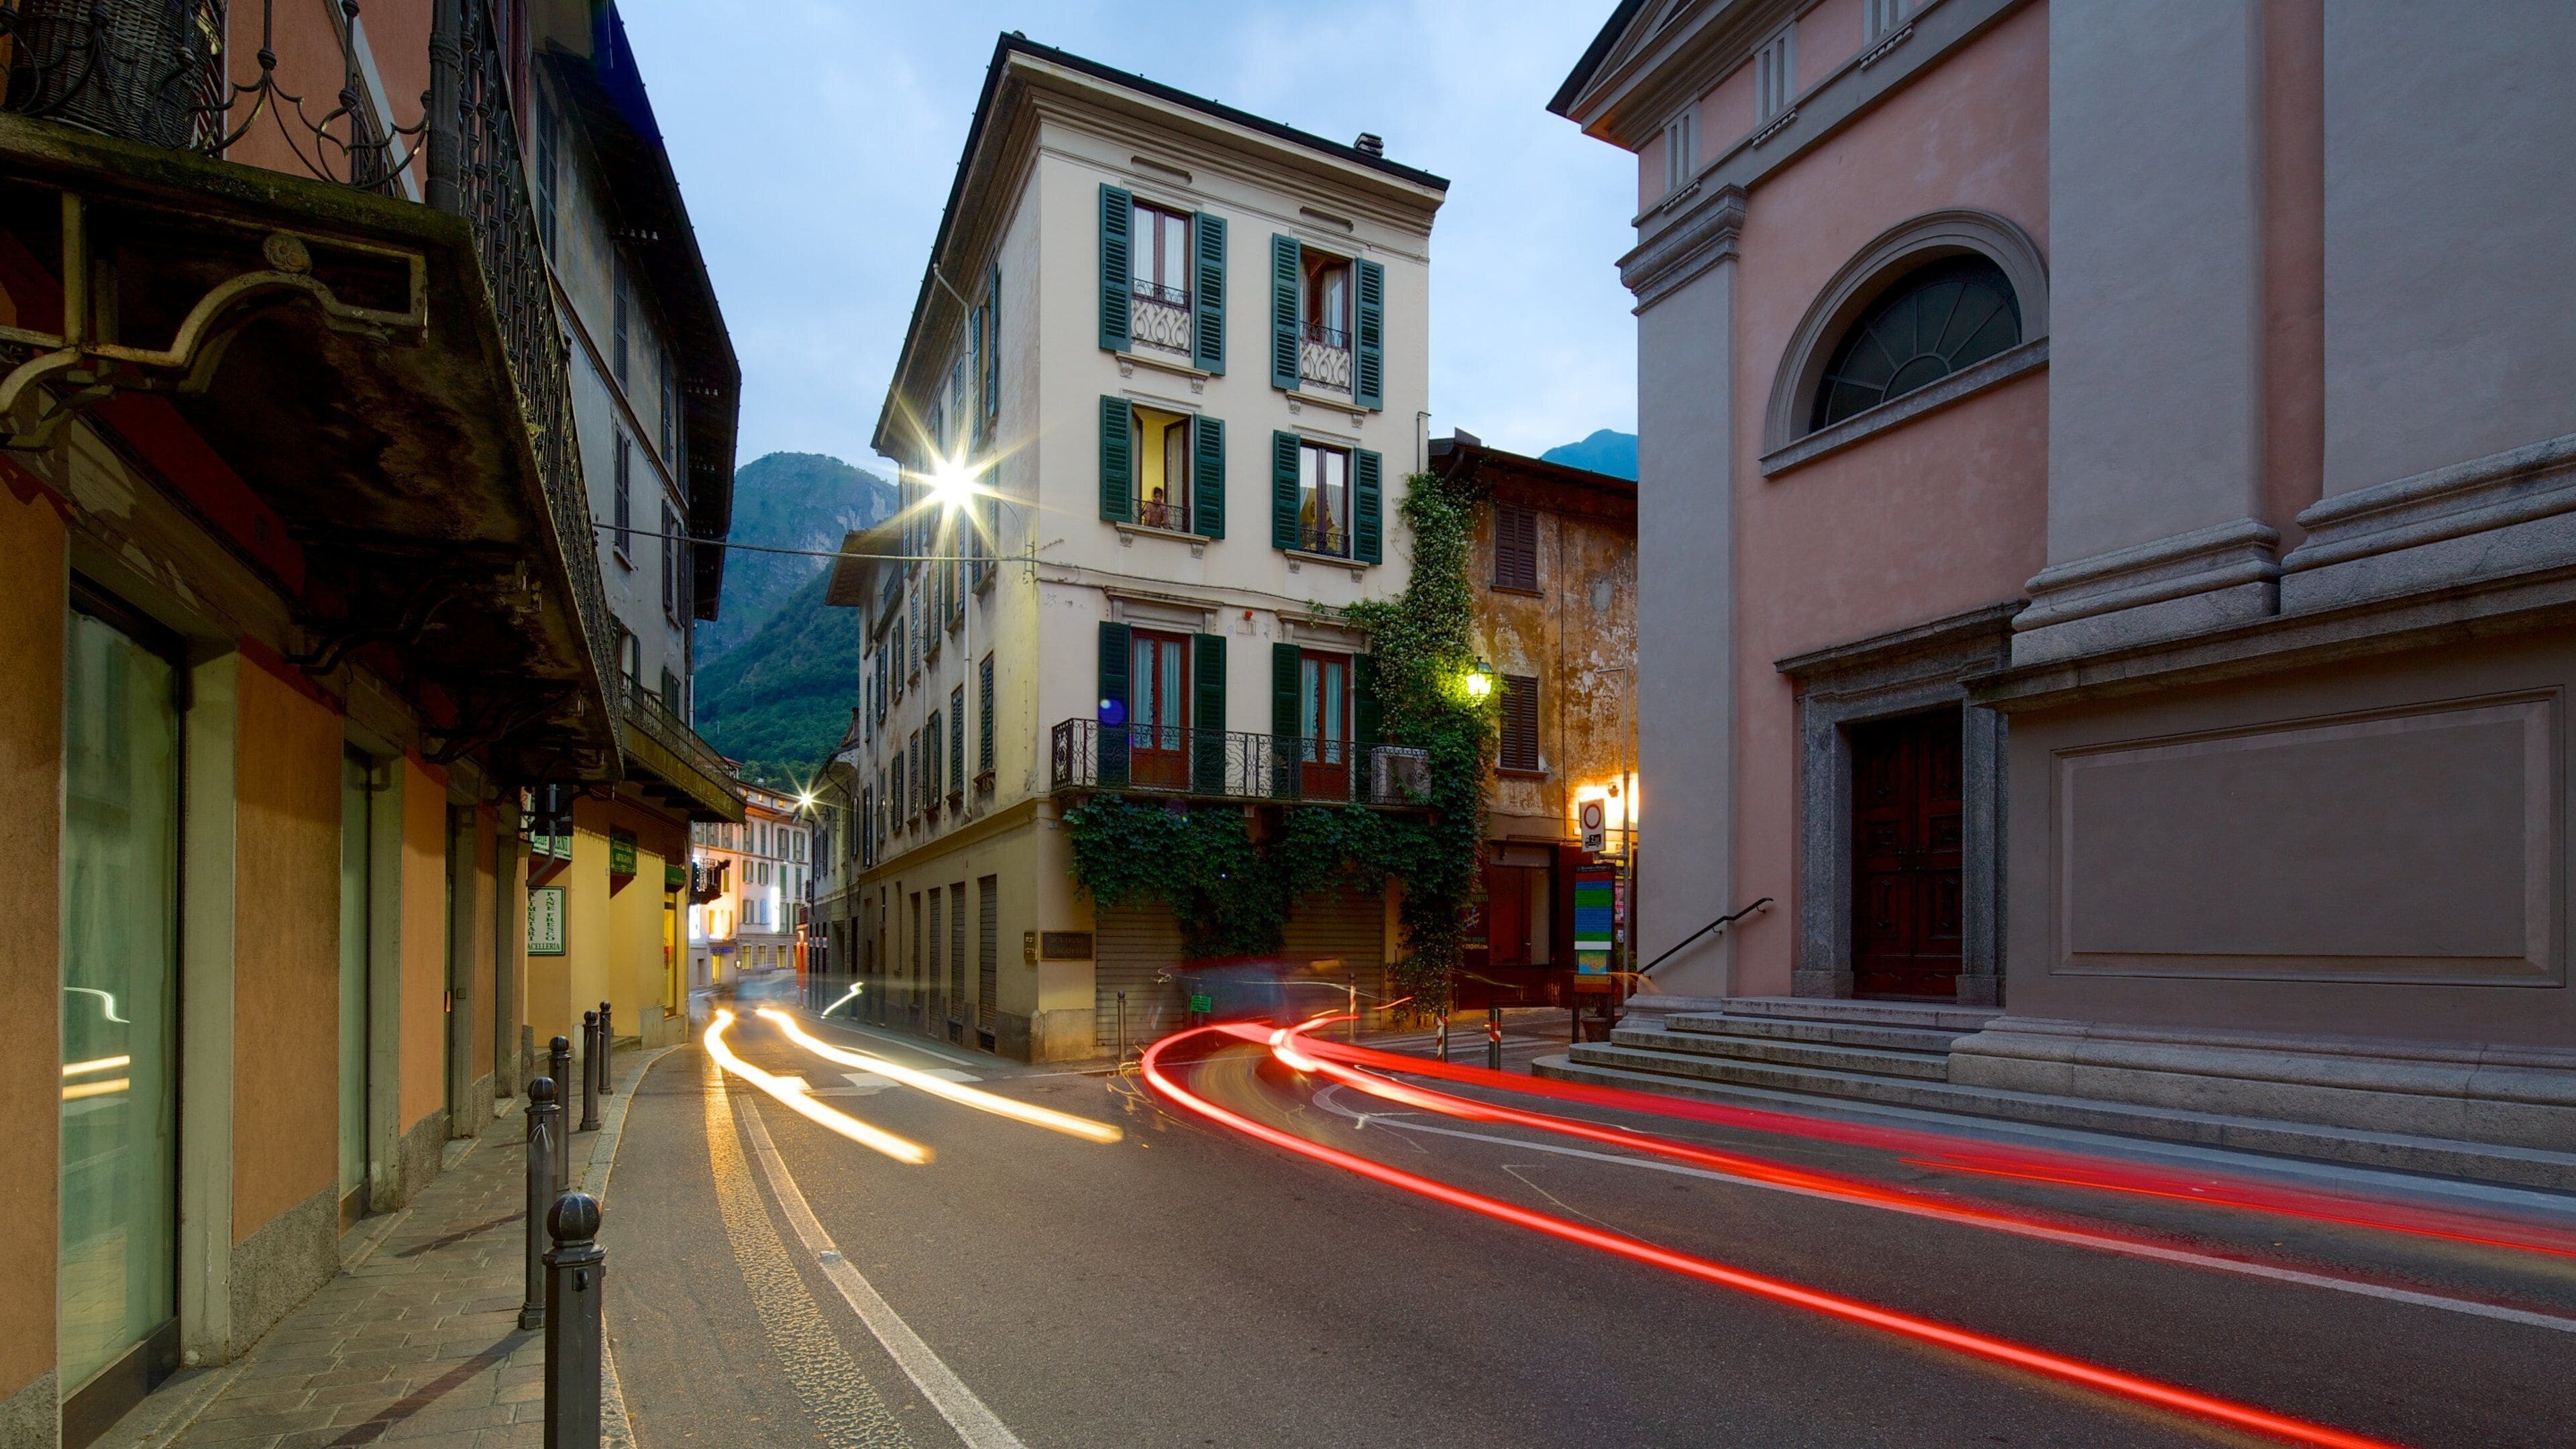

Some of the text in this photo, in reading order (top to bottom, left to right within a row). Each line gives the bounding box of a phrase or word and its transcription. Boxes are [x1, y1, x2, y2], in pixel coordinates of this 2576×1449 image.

[528, 892, 536, 941] ALIMENTARI
[545, 892, 555, 941] PANE FRESCO
[528, 943, 560, 951] ACELLERIA
